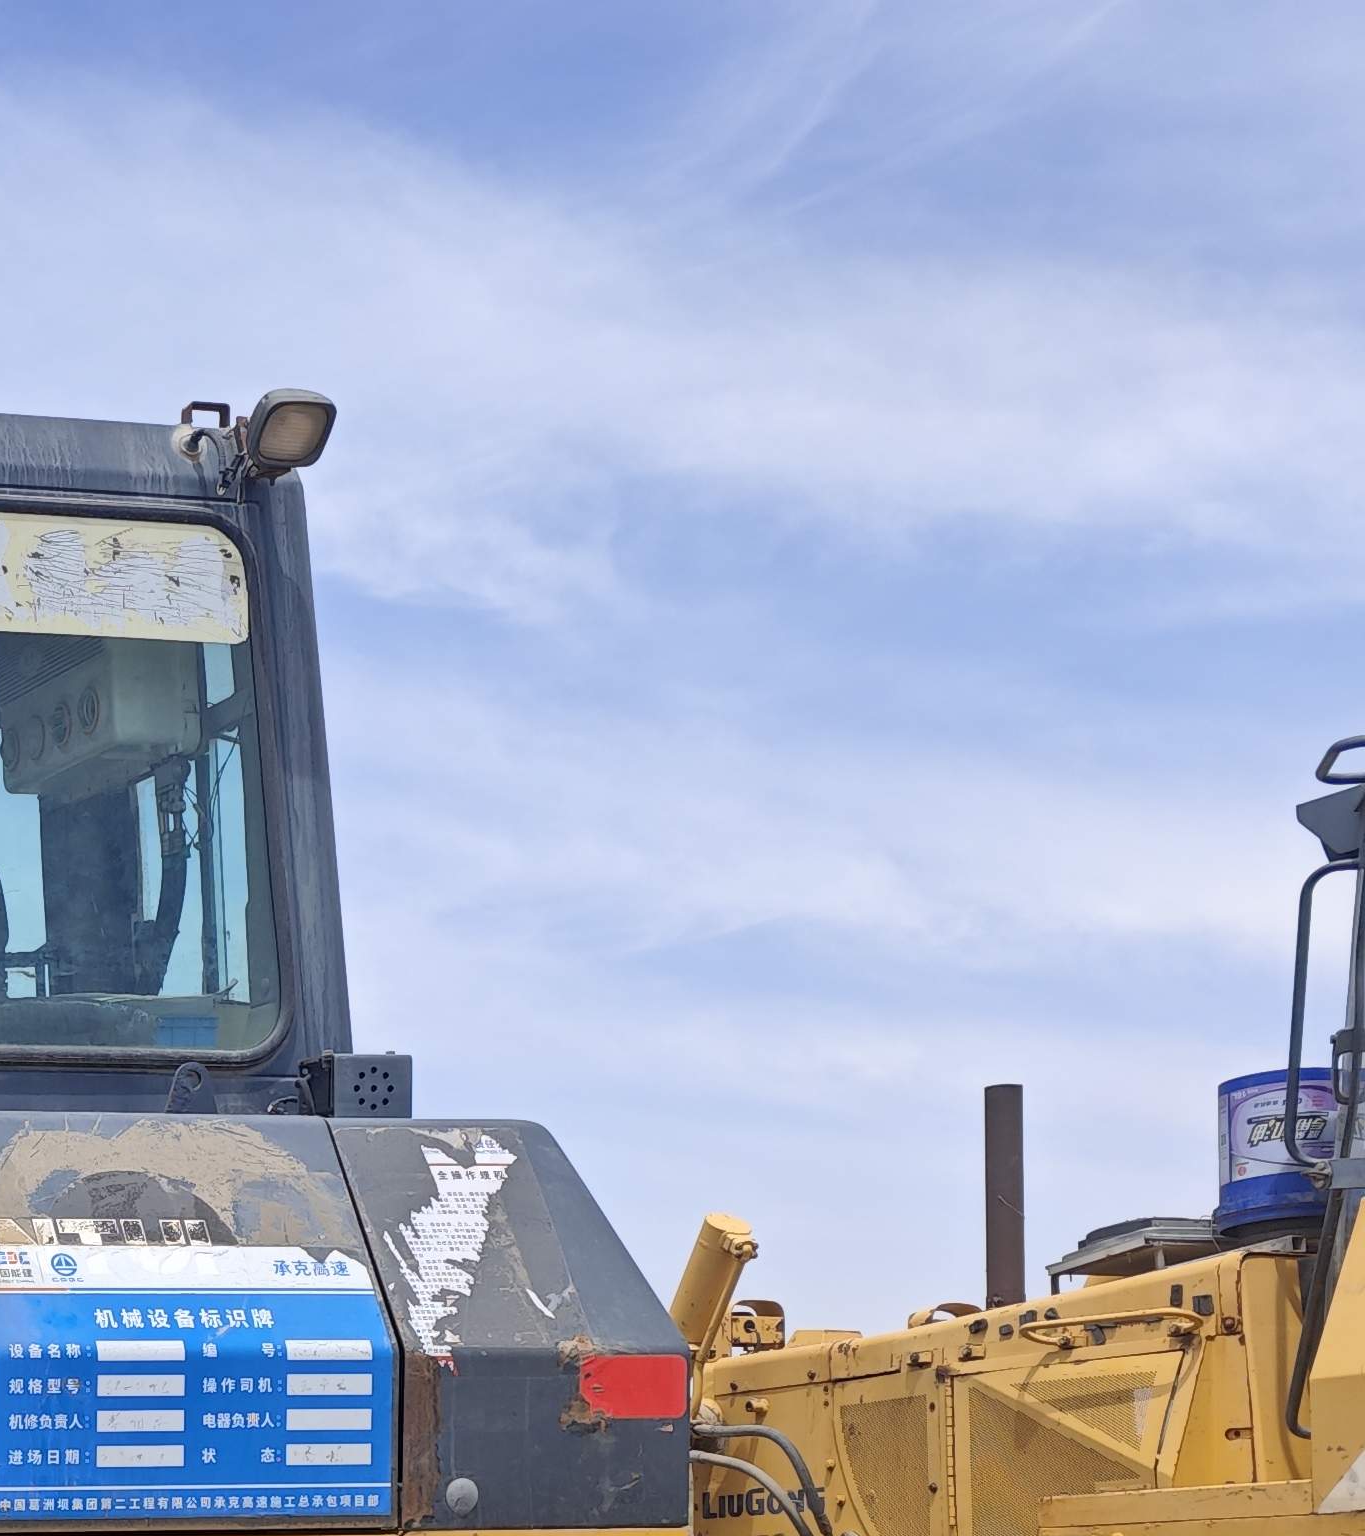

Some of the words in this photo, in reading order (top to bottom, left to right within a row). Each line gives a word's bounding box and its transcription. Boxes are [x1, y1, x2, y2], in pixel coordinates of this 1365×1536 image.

[273, 1259, 351, 1278] 承克高速
[94, 1308, 276, 1330] 机械设备标识牌
[0, 1494, 380, 1512] 中国葛洲坝集团第二工程有限公司承克高速施工总承包项目部
